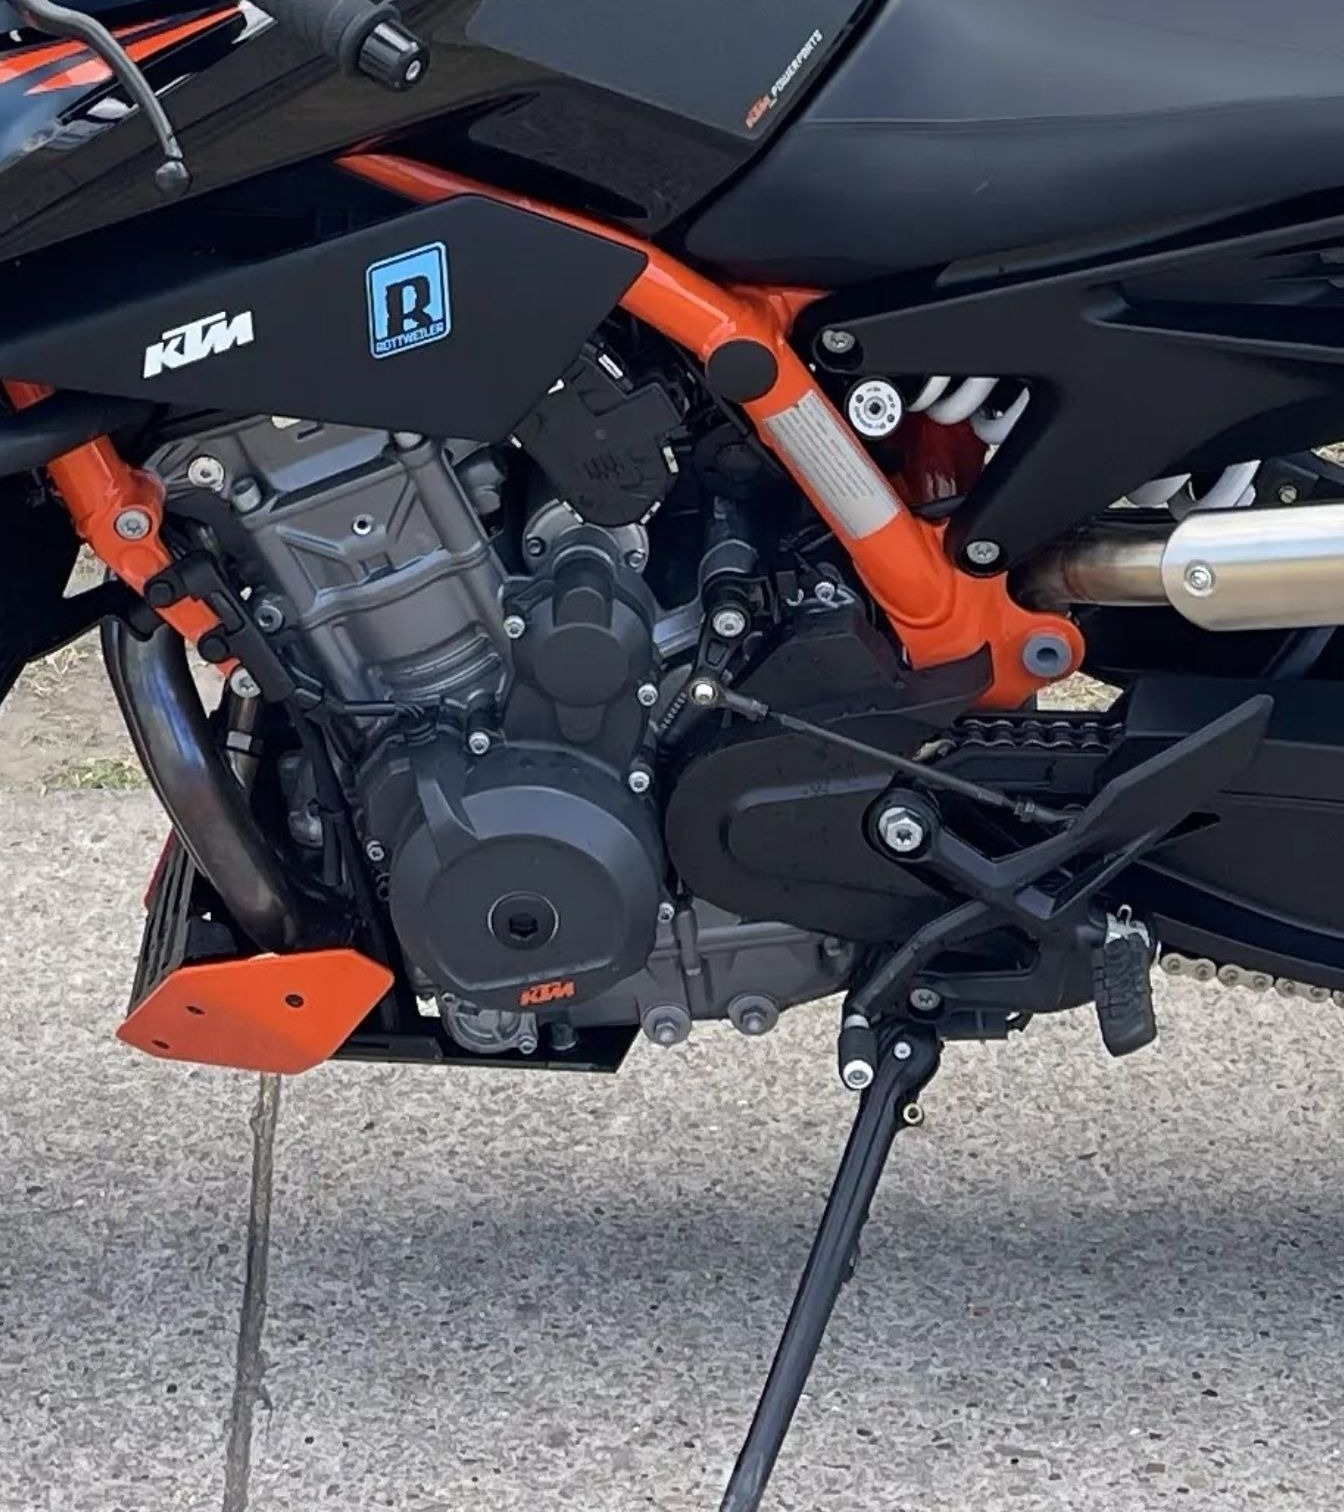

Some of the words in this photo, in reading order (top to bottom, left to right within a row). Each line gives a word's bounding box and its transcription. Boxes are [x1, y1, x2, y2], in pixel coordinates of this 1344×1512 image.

[143, 311, 255, 379] KTM
[375, 322, 445, 353] ROTTWEILER
[520, 981, 575, 1007] KTM
